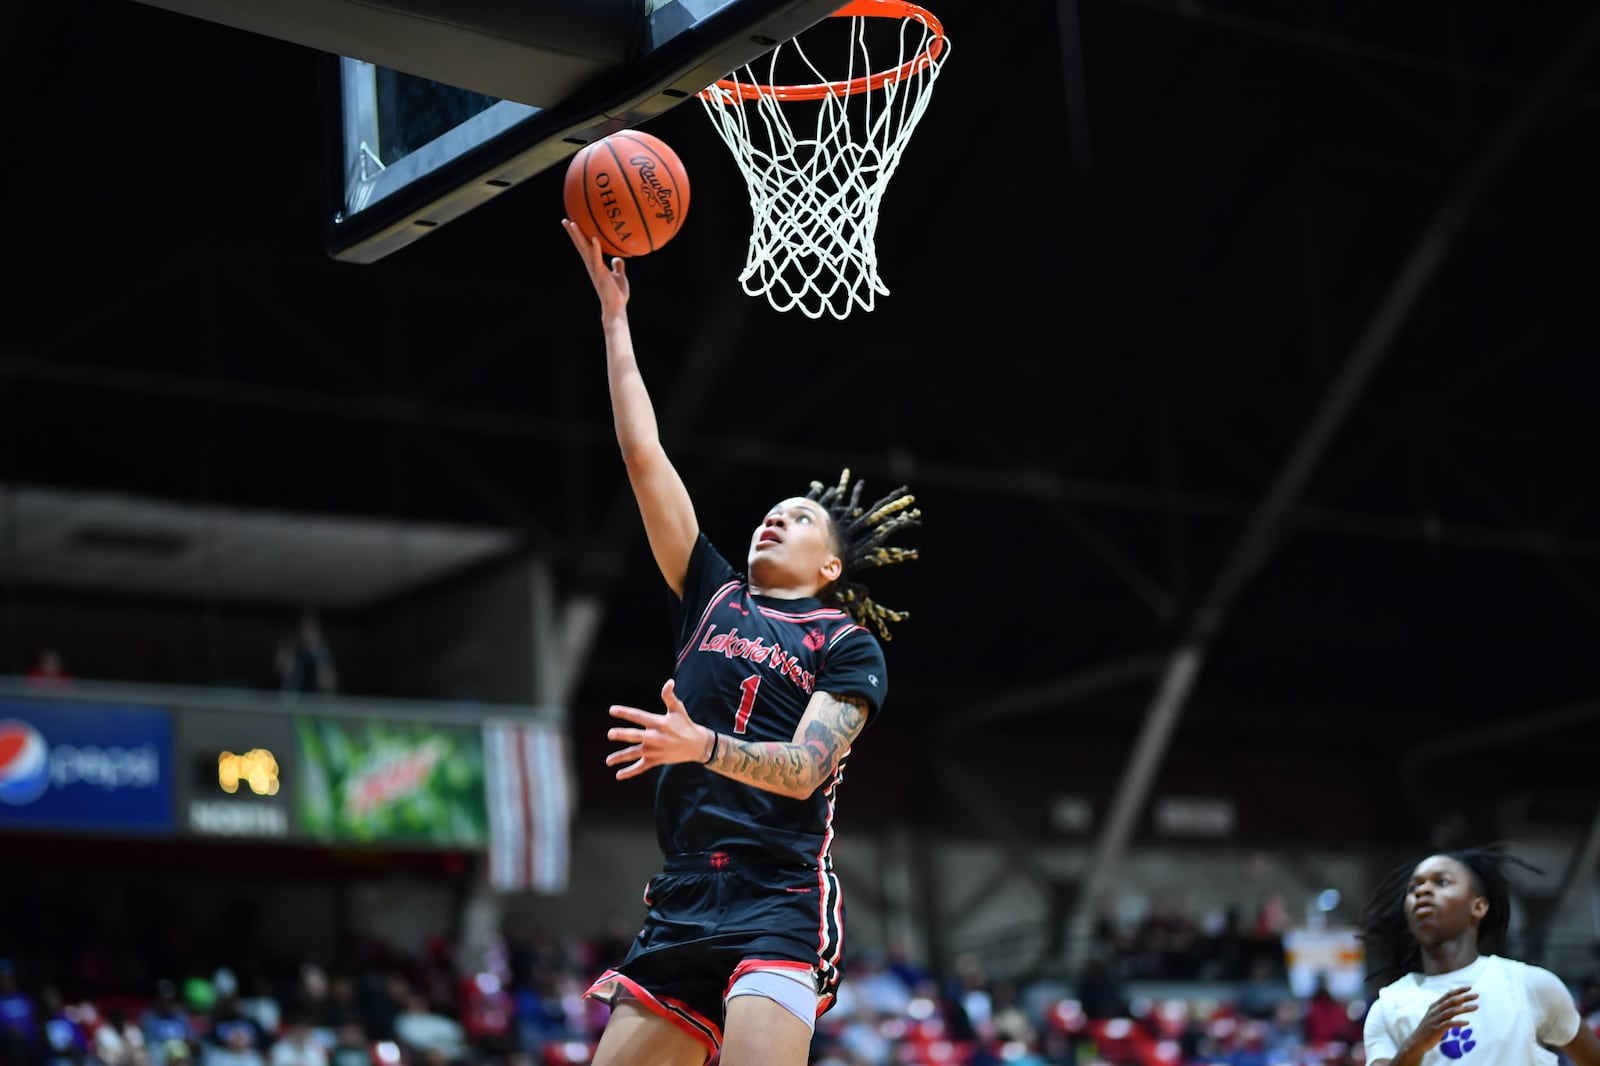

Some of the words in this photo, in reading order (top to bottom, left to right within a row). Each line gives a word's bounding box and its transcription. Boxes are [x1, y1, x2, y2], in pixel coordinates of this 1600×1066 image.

[596, 173, 632, 242] OHSAA
[630, 156, 674, 224] Rawlings
[699, 624, 770, 664] Lakota
[733, 674, 761, 734] 1
